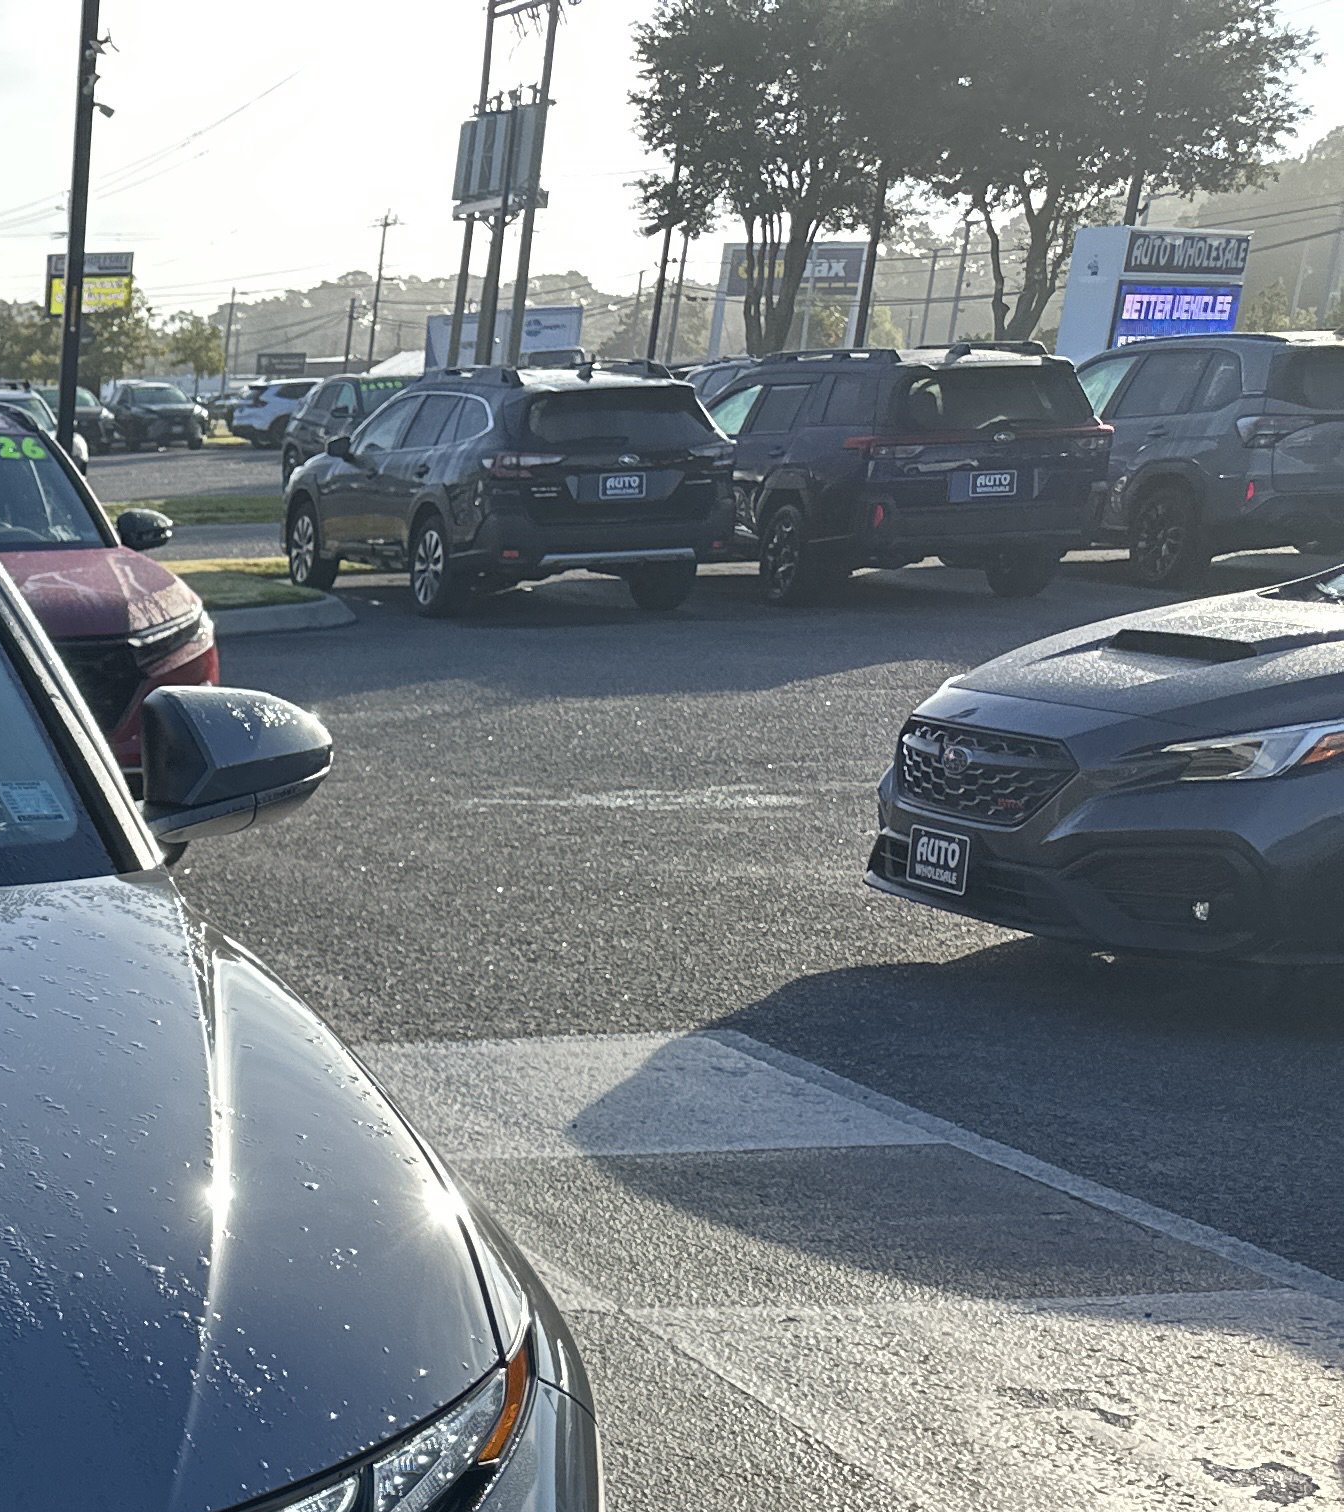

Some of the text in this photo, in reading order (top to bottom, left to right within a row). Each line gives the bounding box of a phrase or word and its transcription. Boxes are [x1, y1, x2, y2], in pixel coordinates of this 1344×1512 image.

[1131, 237, 1247, 269] AUTO WHOLESALE
[1122, 295, 1232, 320] BETTER VEHICLES
[606, 476, 640, 489] AUTO
[976, 474, 1010, 487] AUTO
[916, 836, 960, 868] AUTO
[915, 863, 958, 885] WHOLESALE
